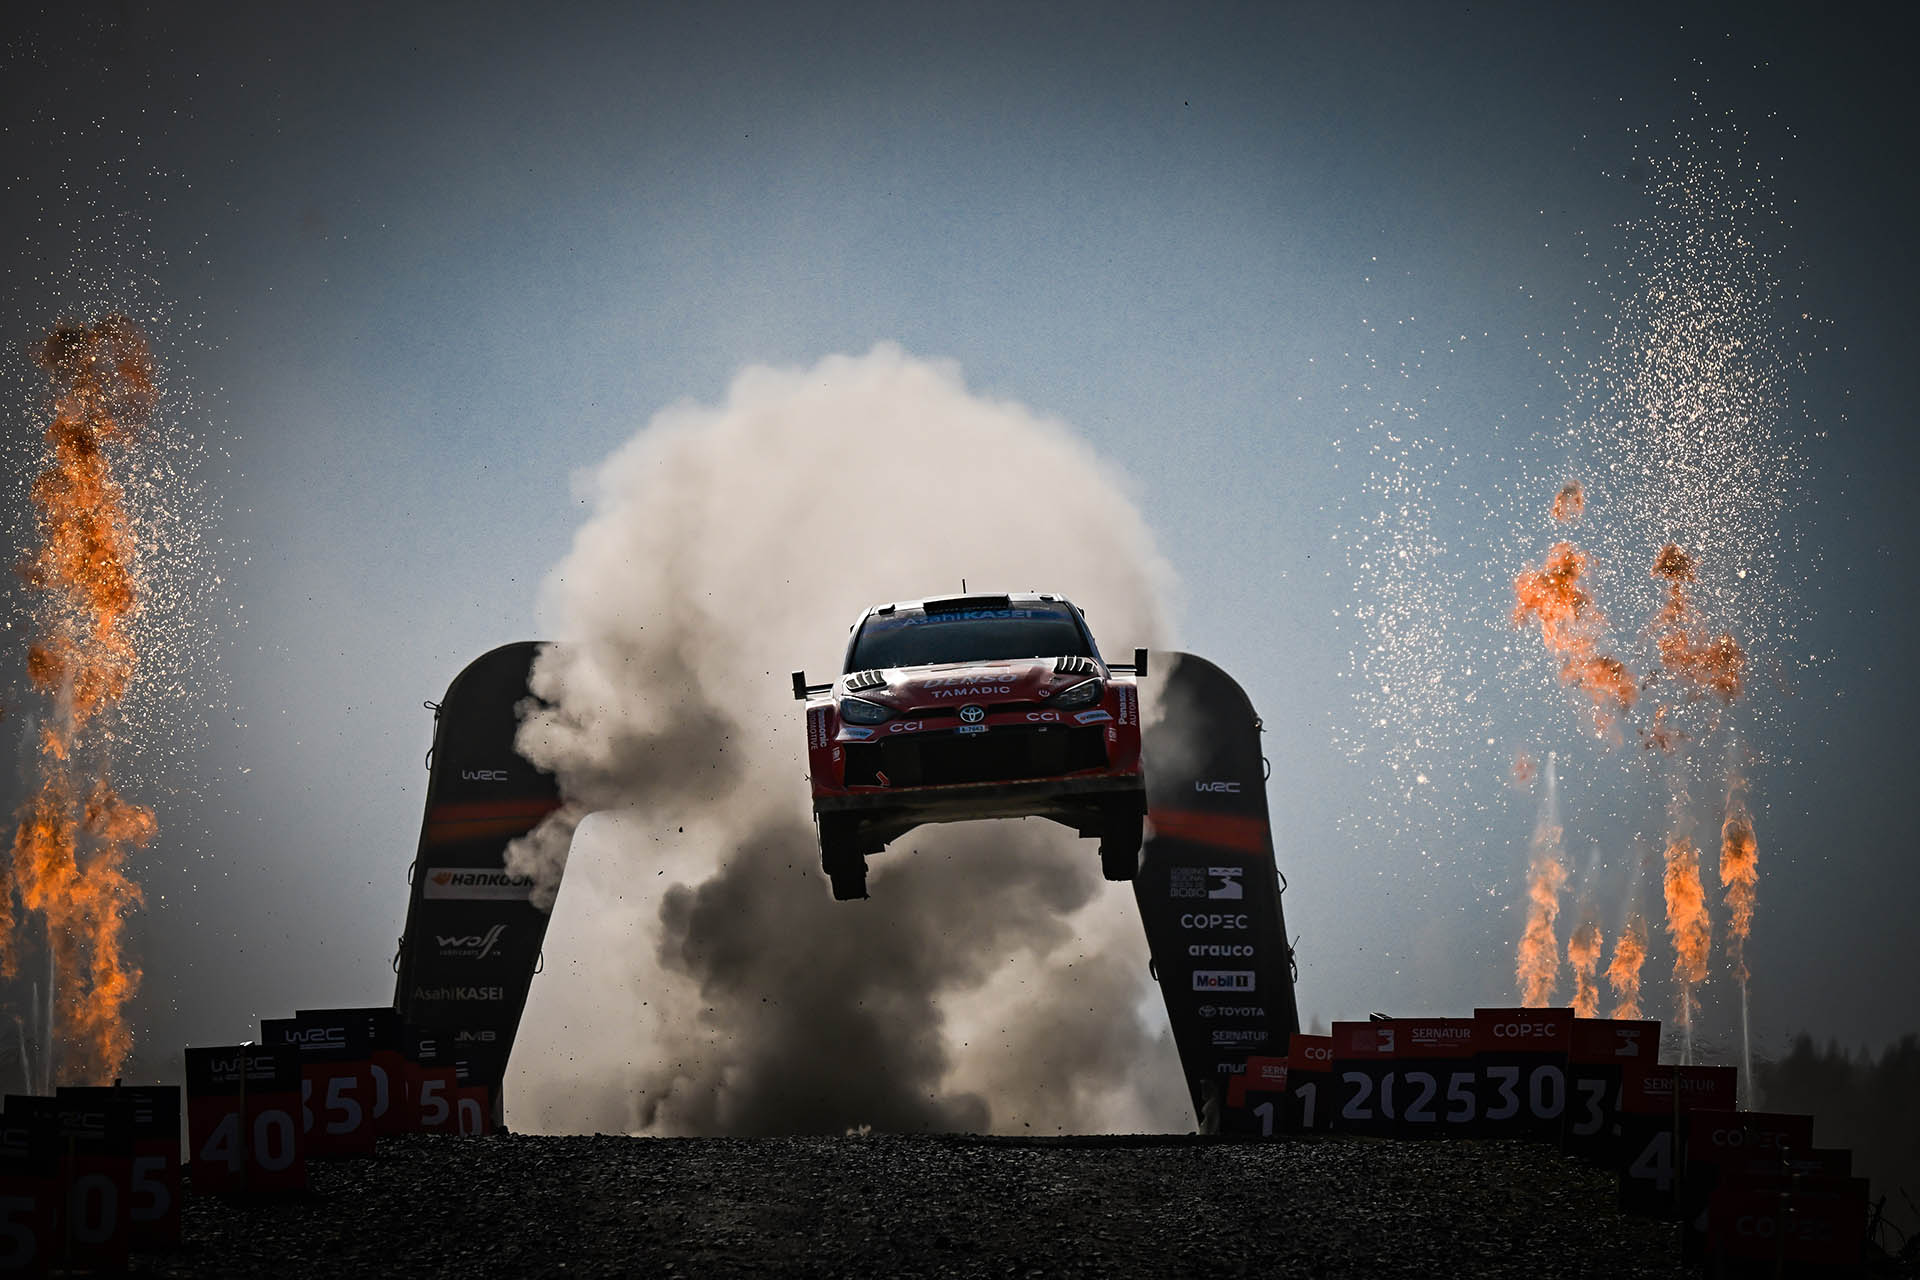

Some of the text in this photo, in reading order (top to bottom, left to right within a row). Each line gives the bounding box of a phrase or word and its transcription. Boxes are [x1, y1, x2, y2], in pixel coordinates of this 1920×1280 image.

[931, 686, 1011, 698] TAMADIC
[1026, 712, 1060, 721] CCI
[889, 721, 923, 733] CCI
[461, 770, 508, 781] WRC
[1196, 781, 1241, 793] WRC
[1180, 914, 1248, 929] COPEC
[1188, 945, 1254, 957] arauco
[1196, 973, 1234, 988] Mobil
[1218, 1006, 1265, 1017] TOYOTA
[1212, 1029, 1269, 1042] SERNATUR
[1411, 1027, 1472, 1039] SERNATUR
[1493, 1023, 1558, 1038] COPEC
[1403, 1071, 1478, 1123] 25
[1485, 1064, 1567, 1120] 30
[1572, 1079, 1623, 1137] 3
[201, 1108, 296, 1174] 40
